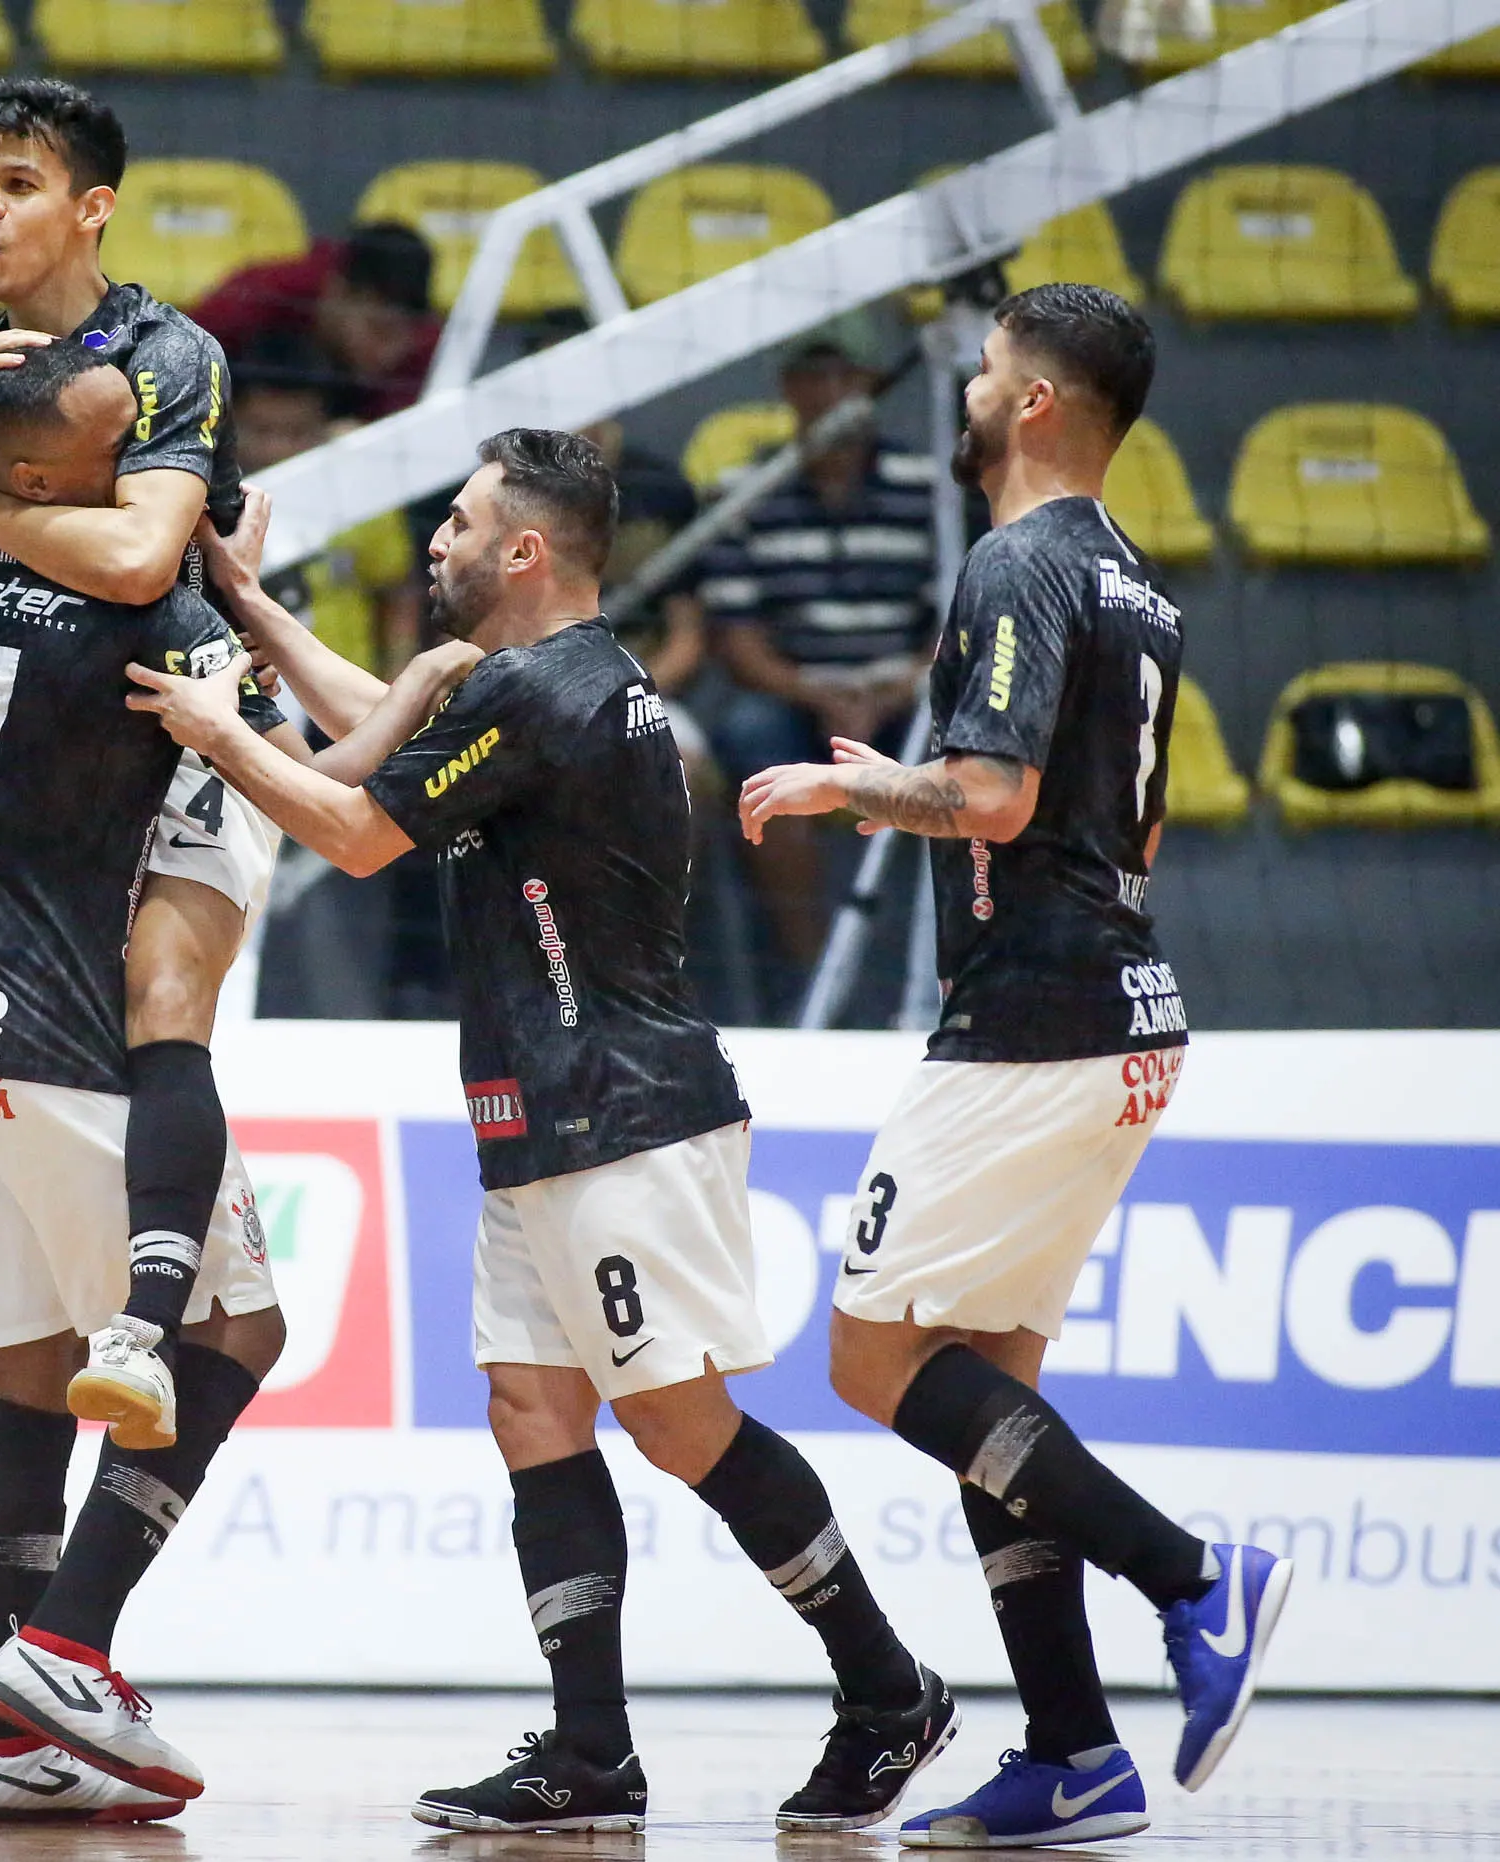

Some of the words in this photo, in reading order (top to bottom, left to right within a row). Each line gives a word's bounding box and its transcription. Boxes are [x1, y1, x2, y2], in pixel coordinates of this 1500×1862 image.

[1100, 558, 1181, 626] Master
[988, 615, 1018, 712] UNIP
[424, 727, 501, 799] UNIP
[185, 775, 225, 837] 4
[534, 903, 579, 1027] marjosports
[856, 1172, 898, 1256] 3
[594, 1254, 644, 1337] 8
[206, 1470, 286, 1558] A
